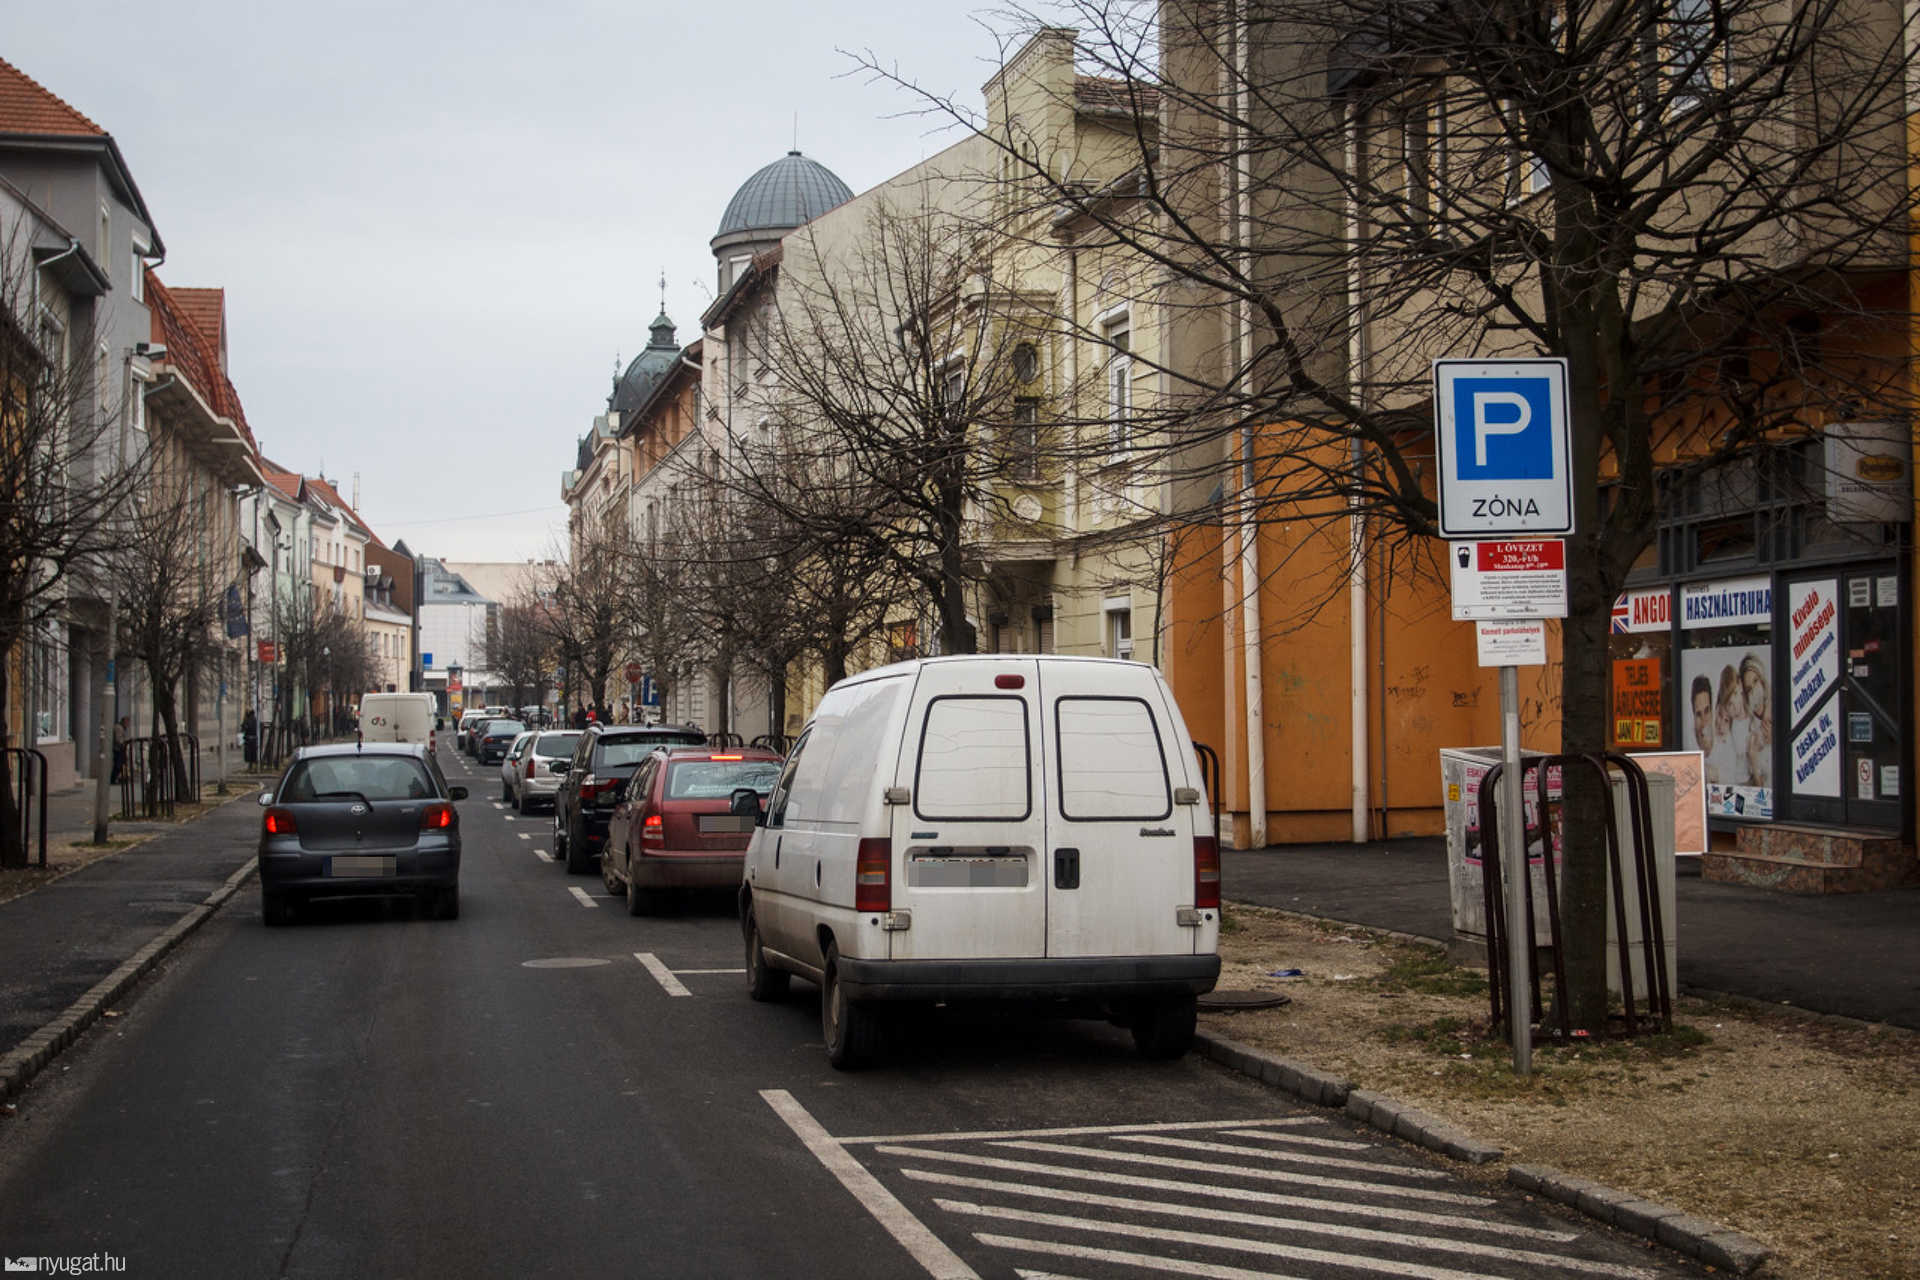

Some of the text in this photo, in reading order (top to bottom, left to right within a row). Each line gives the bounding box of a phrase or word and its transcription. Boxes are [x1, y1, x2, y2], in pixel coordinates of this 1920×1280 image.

[1474, 391, 1532, 467] P
[1472, 494, 1540, 517] ZÓNA
[1686, 589, 1771, 621] HASZNÁLTRUHA
[1792, 587, 1819, 630] Kiváló
[1794, 667, 1826, 714] ruházat
